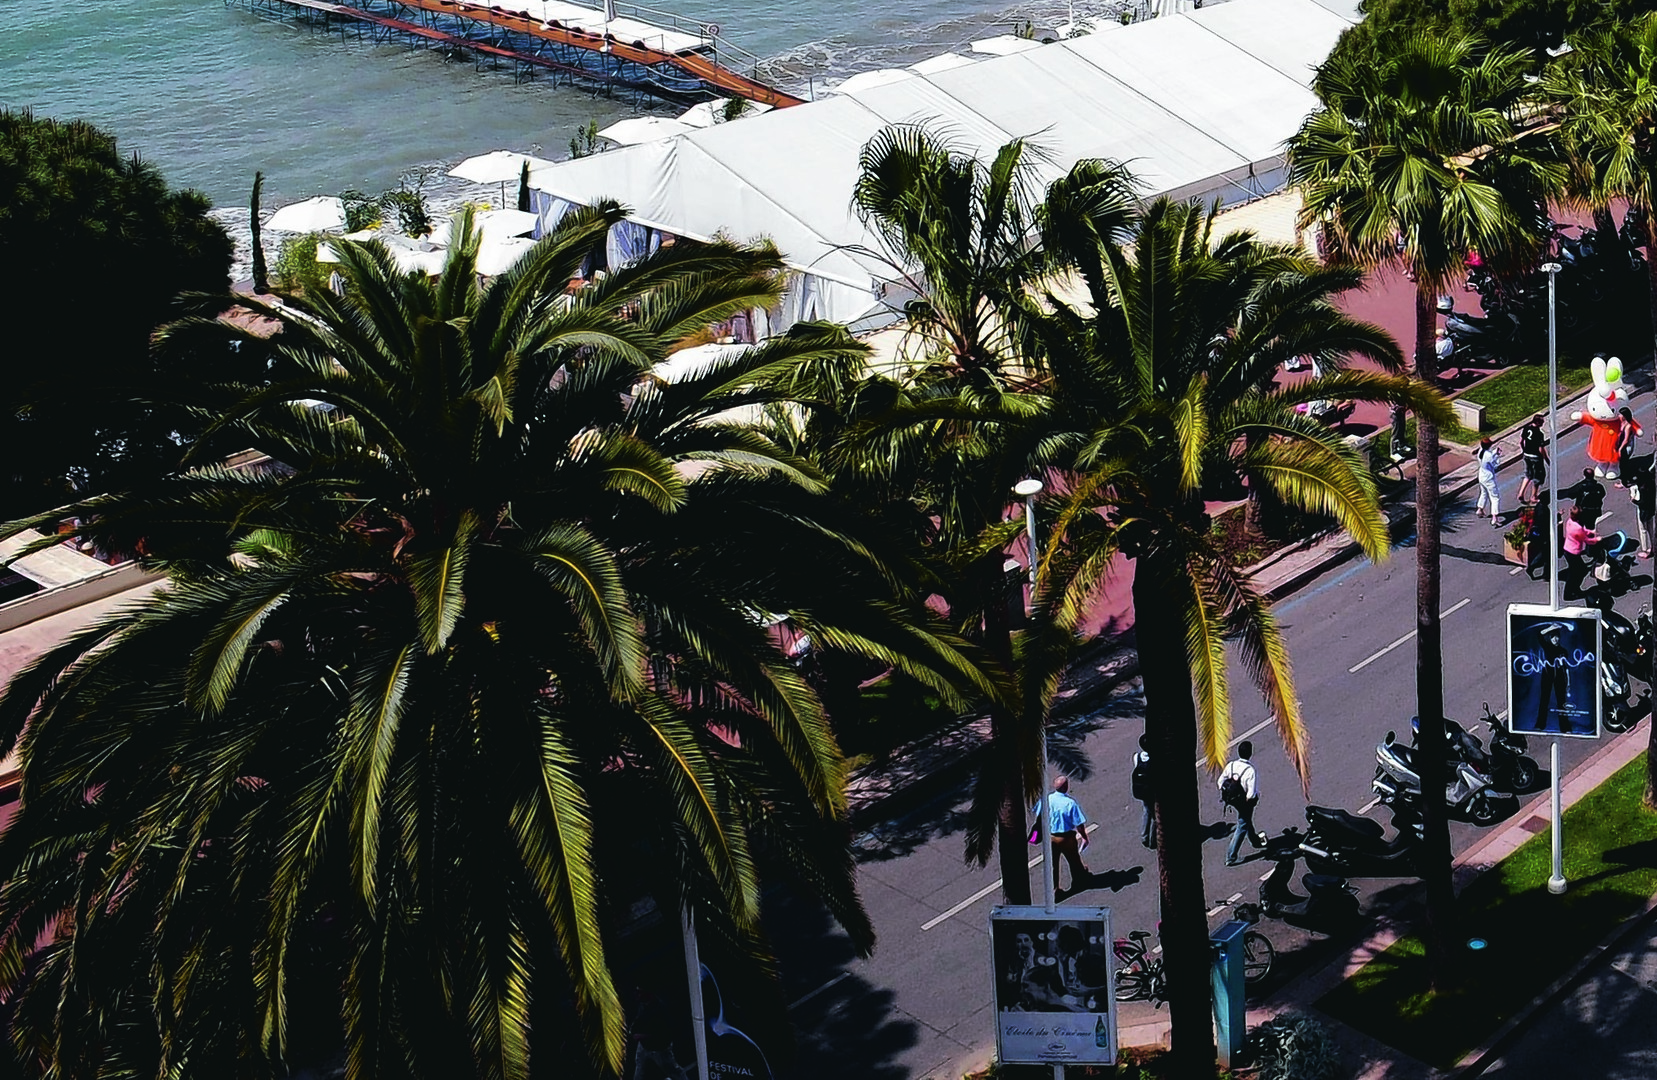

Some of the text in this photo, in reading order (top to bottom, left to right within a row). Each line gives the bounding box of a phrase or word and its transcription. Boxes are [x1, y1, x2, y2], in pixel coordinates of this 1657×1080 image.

[1527, 429, 1533, 440] 2
[1035, 1027, 1049, 1037] du
[709, 1060, 754, 1077] FESTIVAL
